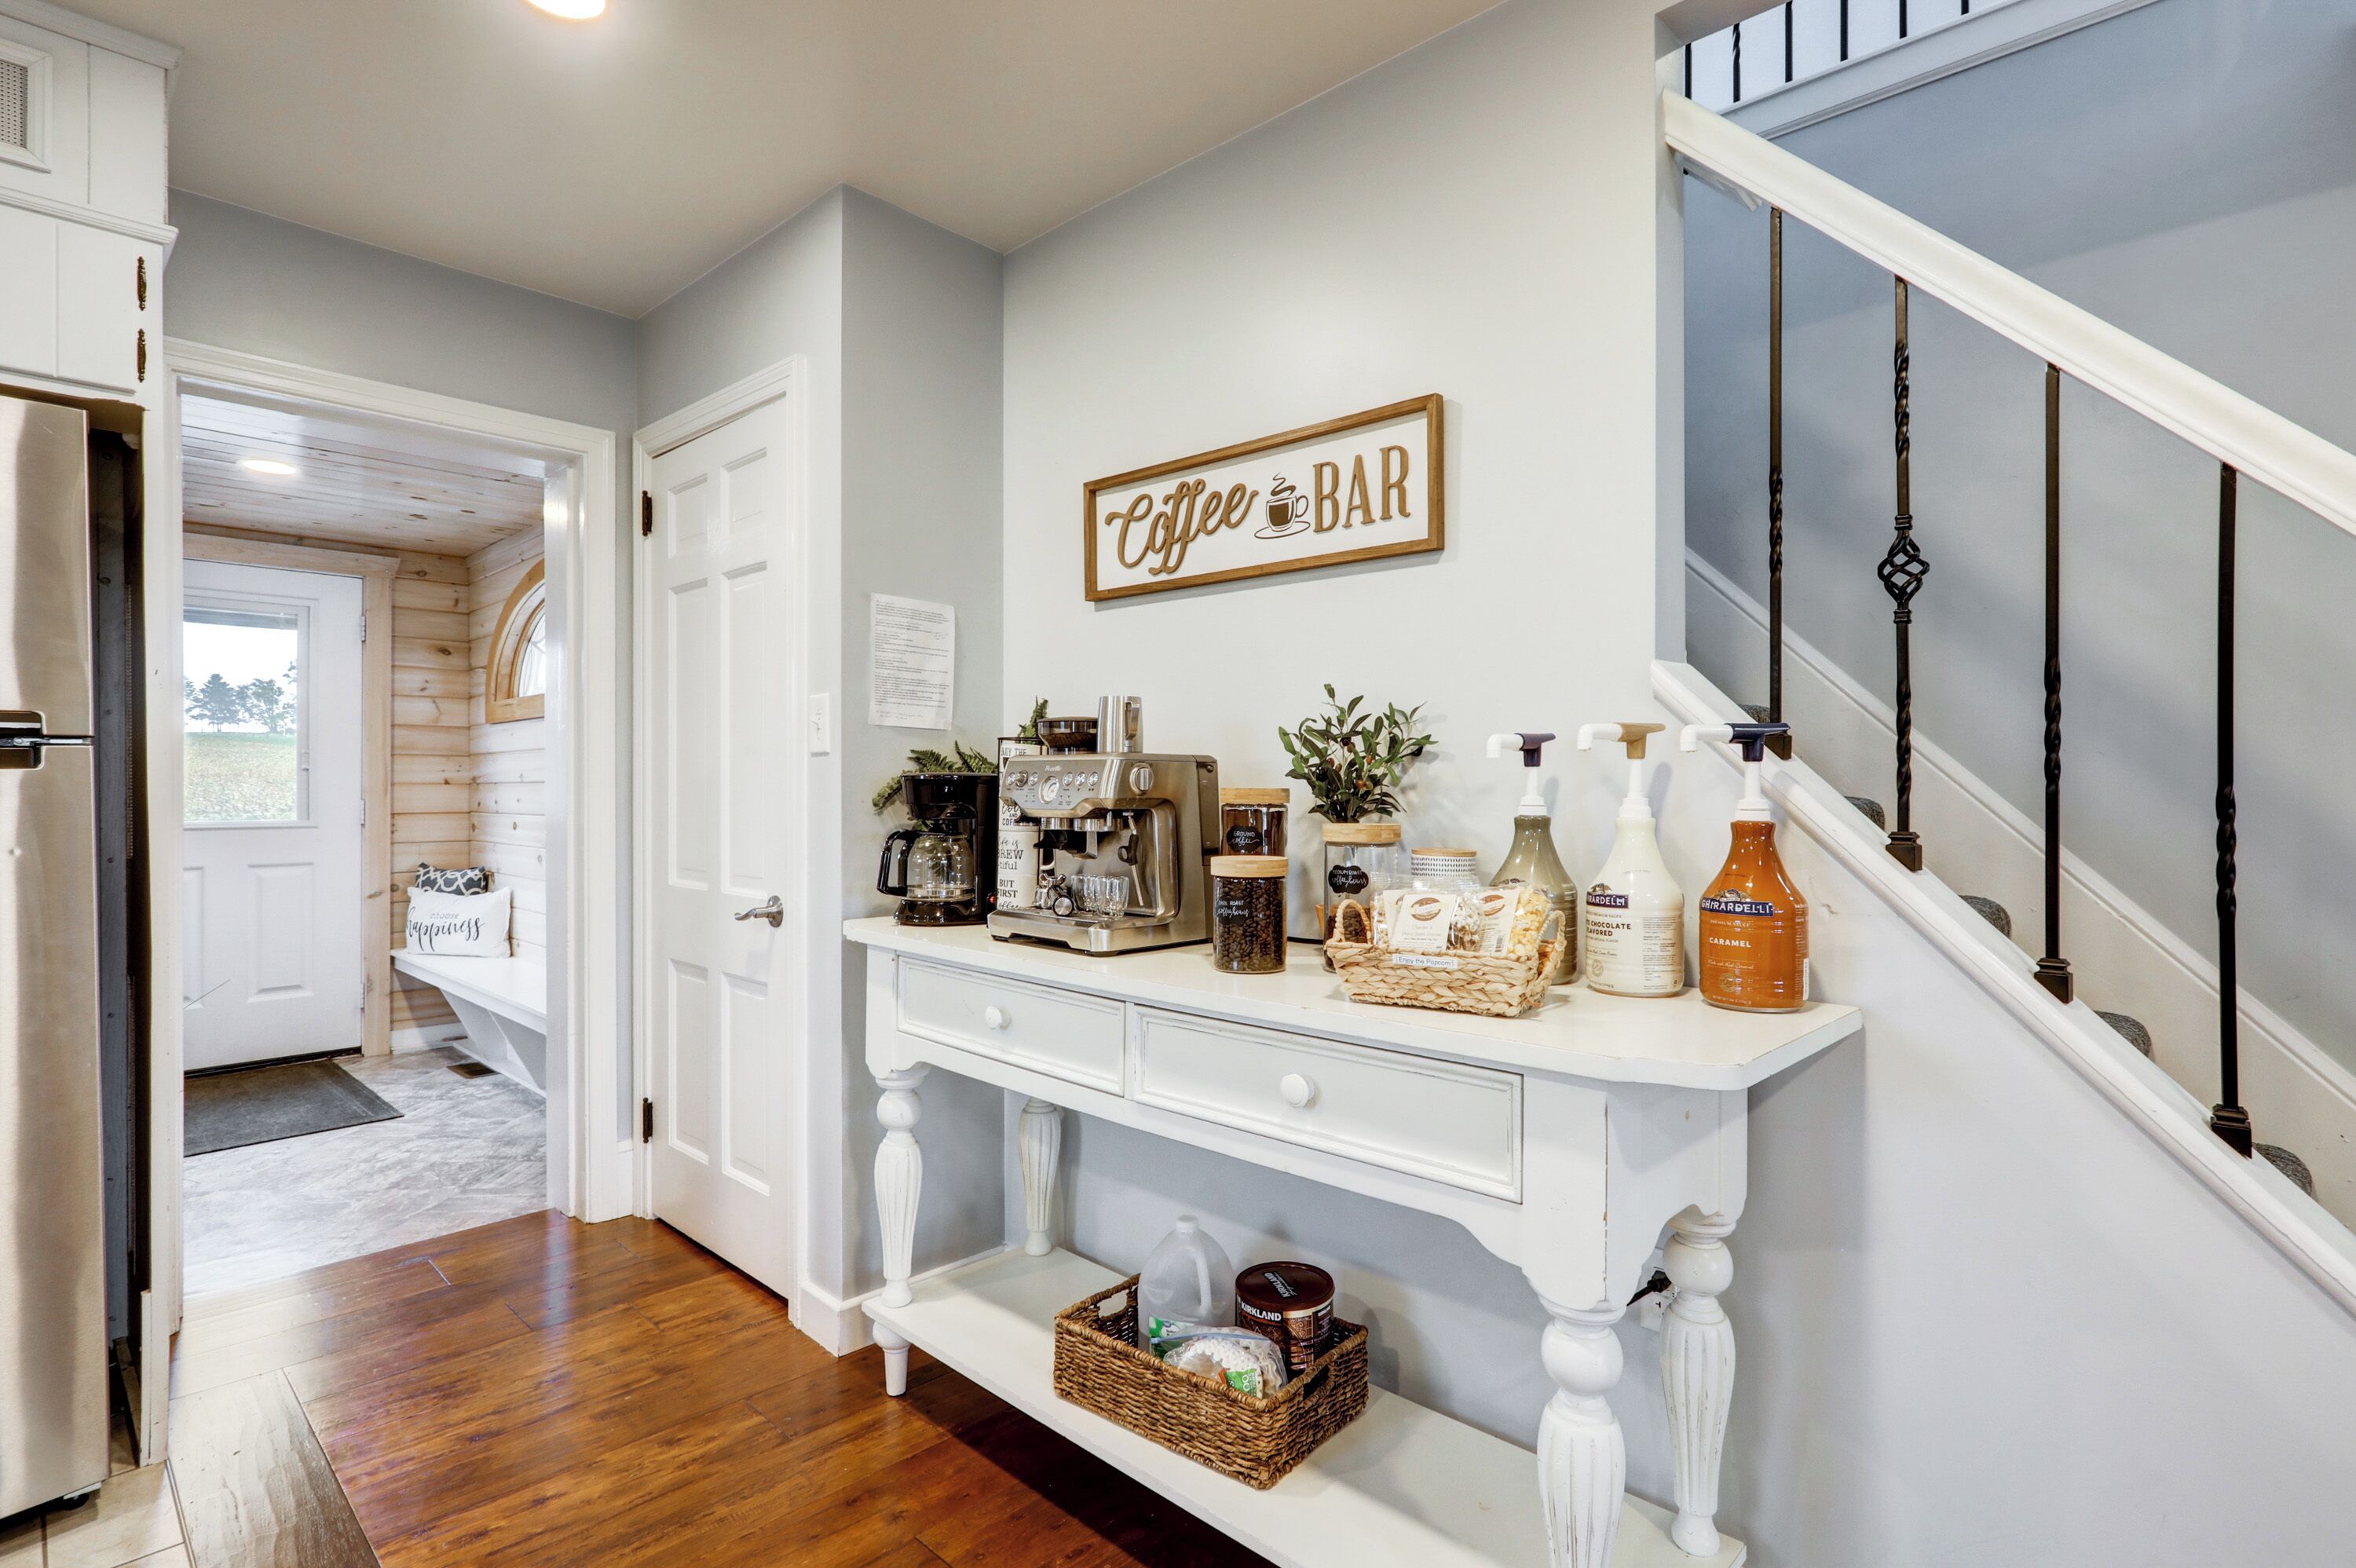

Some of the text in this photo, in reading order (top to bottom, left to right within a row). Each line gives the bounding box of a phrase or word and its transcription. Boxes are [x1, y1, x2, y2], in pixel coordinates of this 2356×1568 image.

[1105, 444, 1411, 576] Coffee BAR
[997, 849, 1023, 860] REW
[999, 879, 1015, 888] BUT
[1701, 899, 1769, 913] GHIRARDELLI
[407, 906, 485, 952] happiness
[1590, 920, 1631, 930] CHOCOLATE
[1709, 937, 1752, 948] CARAMEL
[1398, 956, 1414, 965] Enjoy
[1264, 1273, 1290, 1298] KIRKLAND
[1241, 1301, 1282, 1321] KIRKLAND
